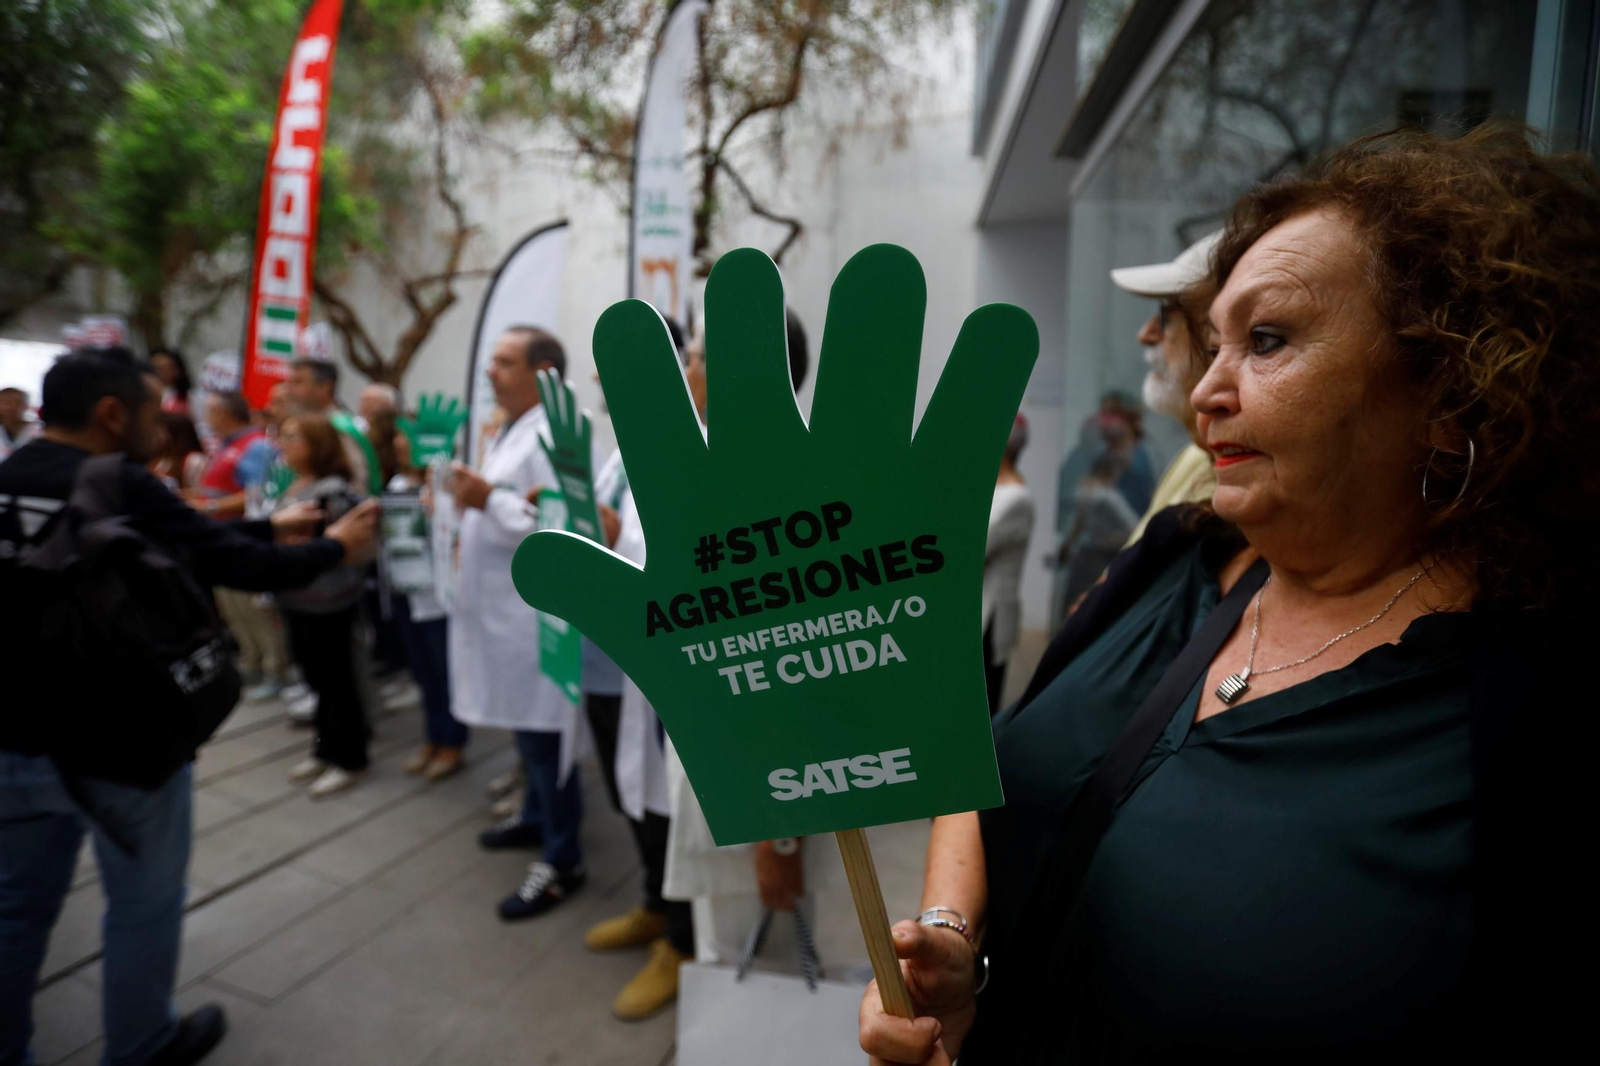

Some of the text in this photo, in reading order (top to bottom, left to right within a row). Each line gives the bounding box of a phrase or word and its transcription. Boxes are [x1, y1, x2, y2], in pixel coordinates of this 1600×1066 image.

[694, 502, 852, 573] #STOP
[647, 535, 944, 637] AGRESIONES
[682, 596, 926, 665] TU ENFERMERA/O
[719, 633, 906, 695] TE CUIDA
[768, 748, 916, 801] SATSE
